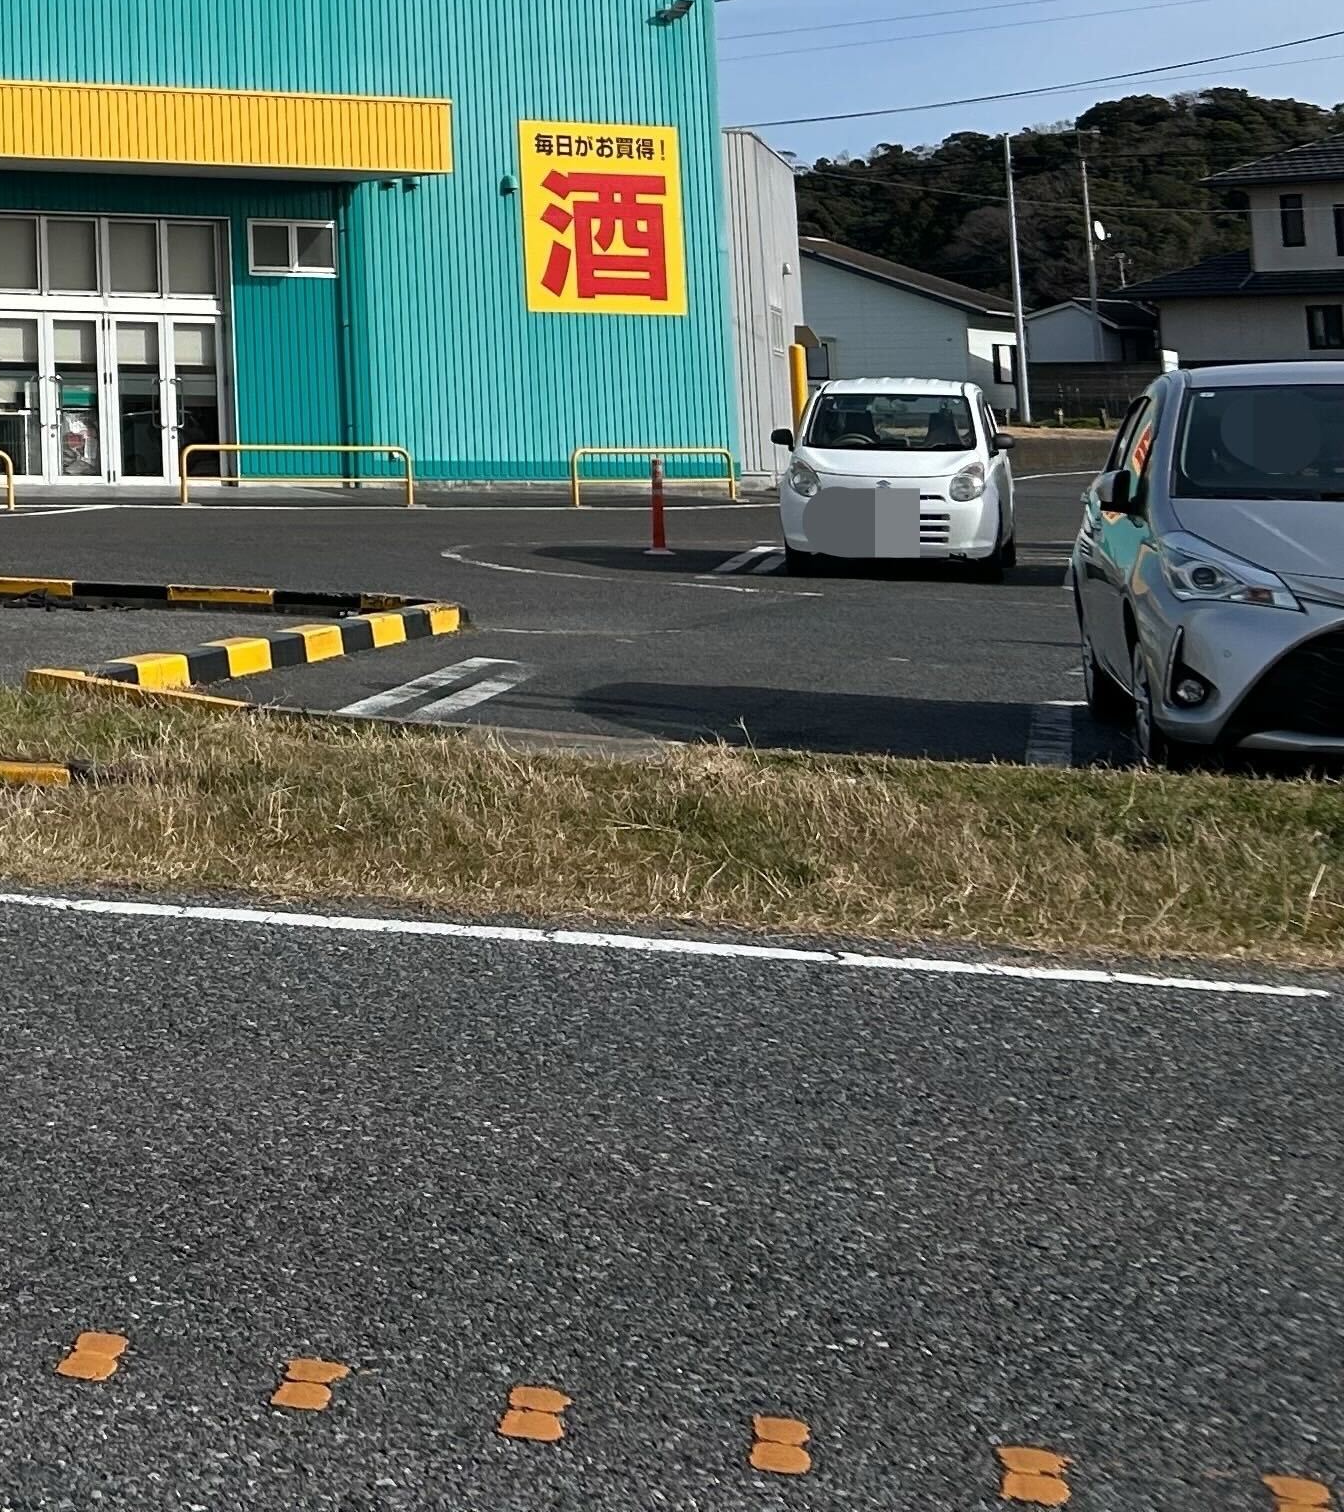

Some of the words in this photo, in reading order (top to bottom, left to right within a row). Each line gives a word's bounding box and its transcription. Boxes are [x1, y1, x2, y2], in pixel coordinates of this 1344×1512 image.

[534, 132, 666, 161] 毎日がお買得！
[539, 169, 668, 301] 酒
